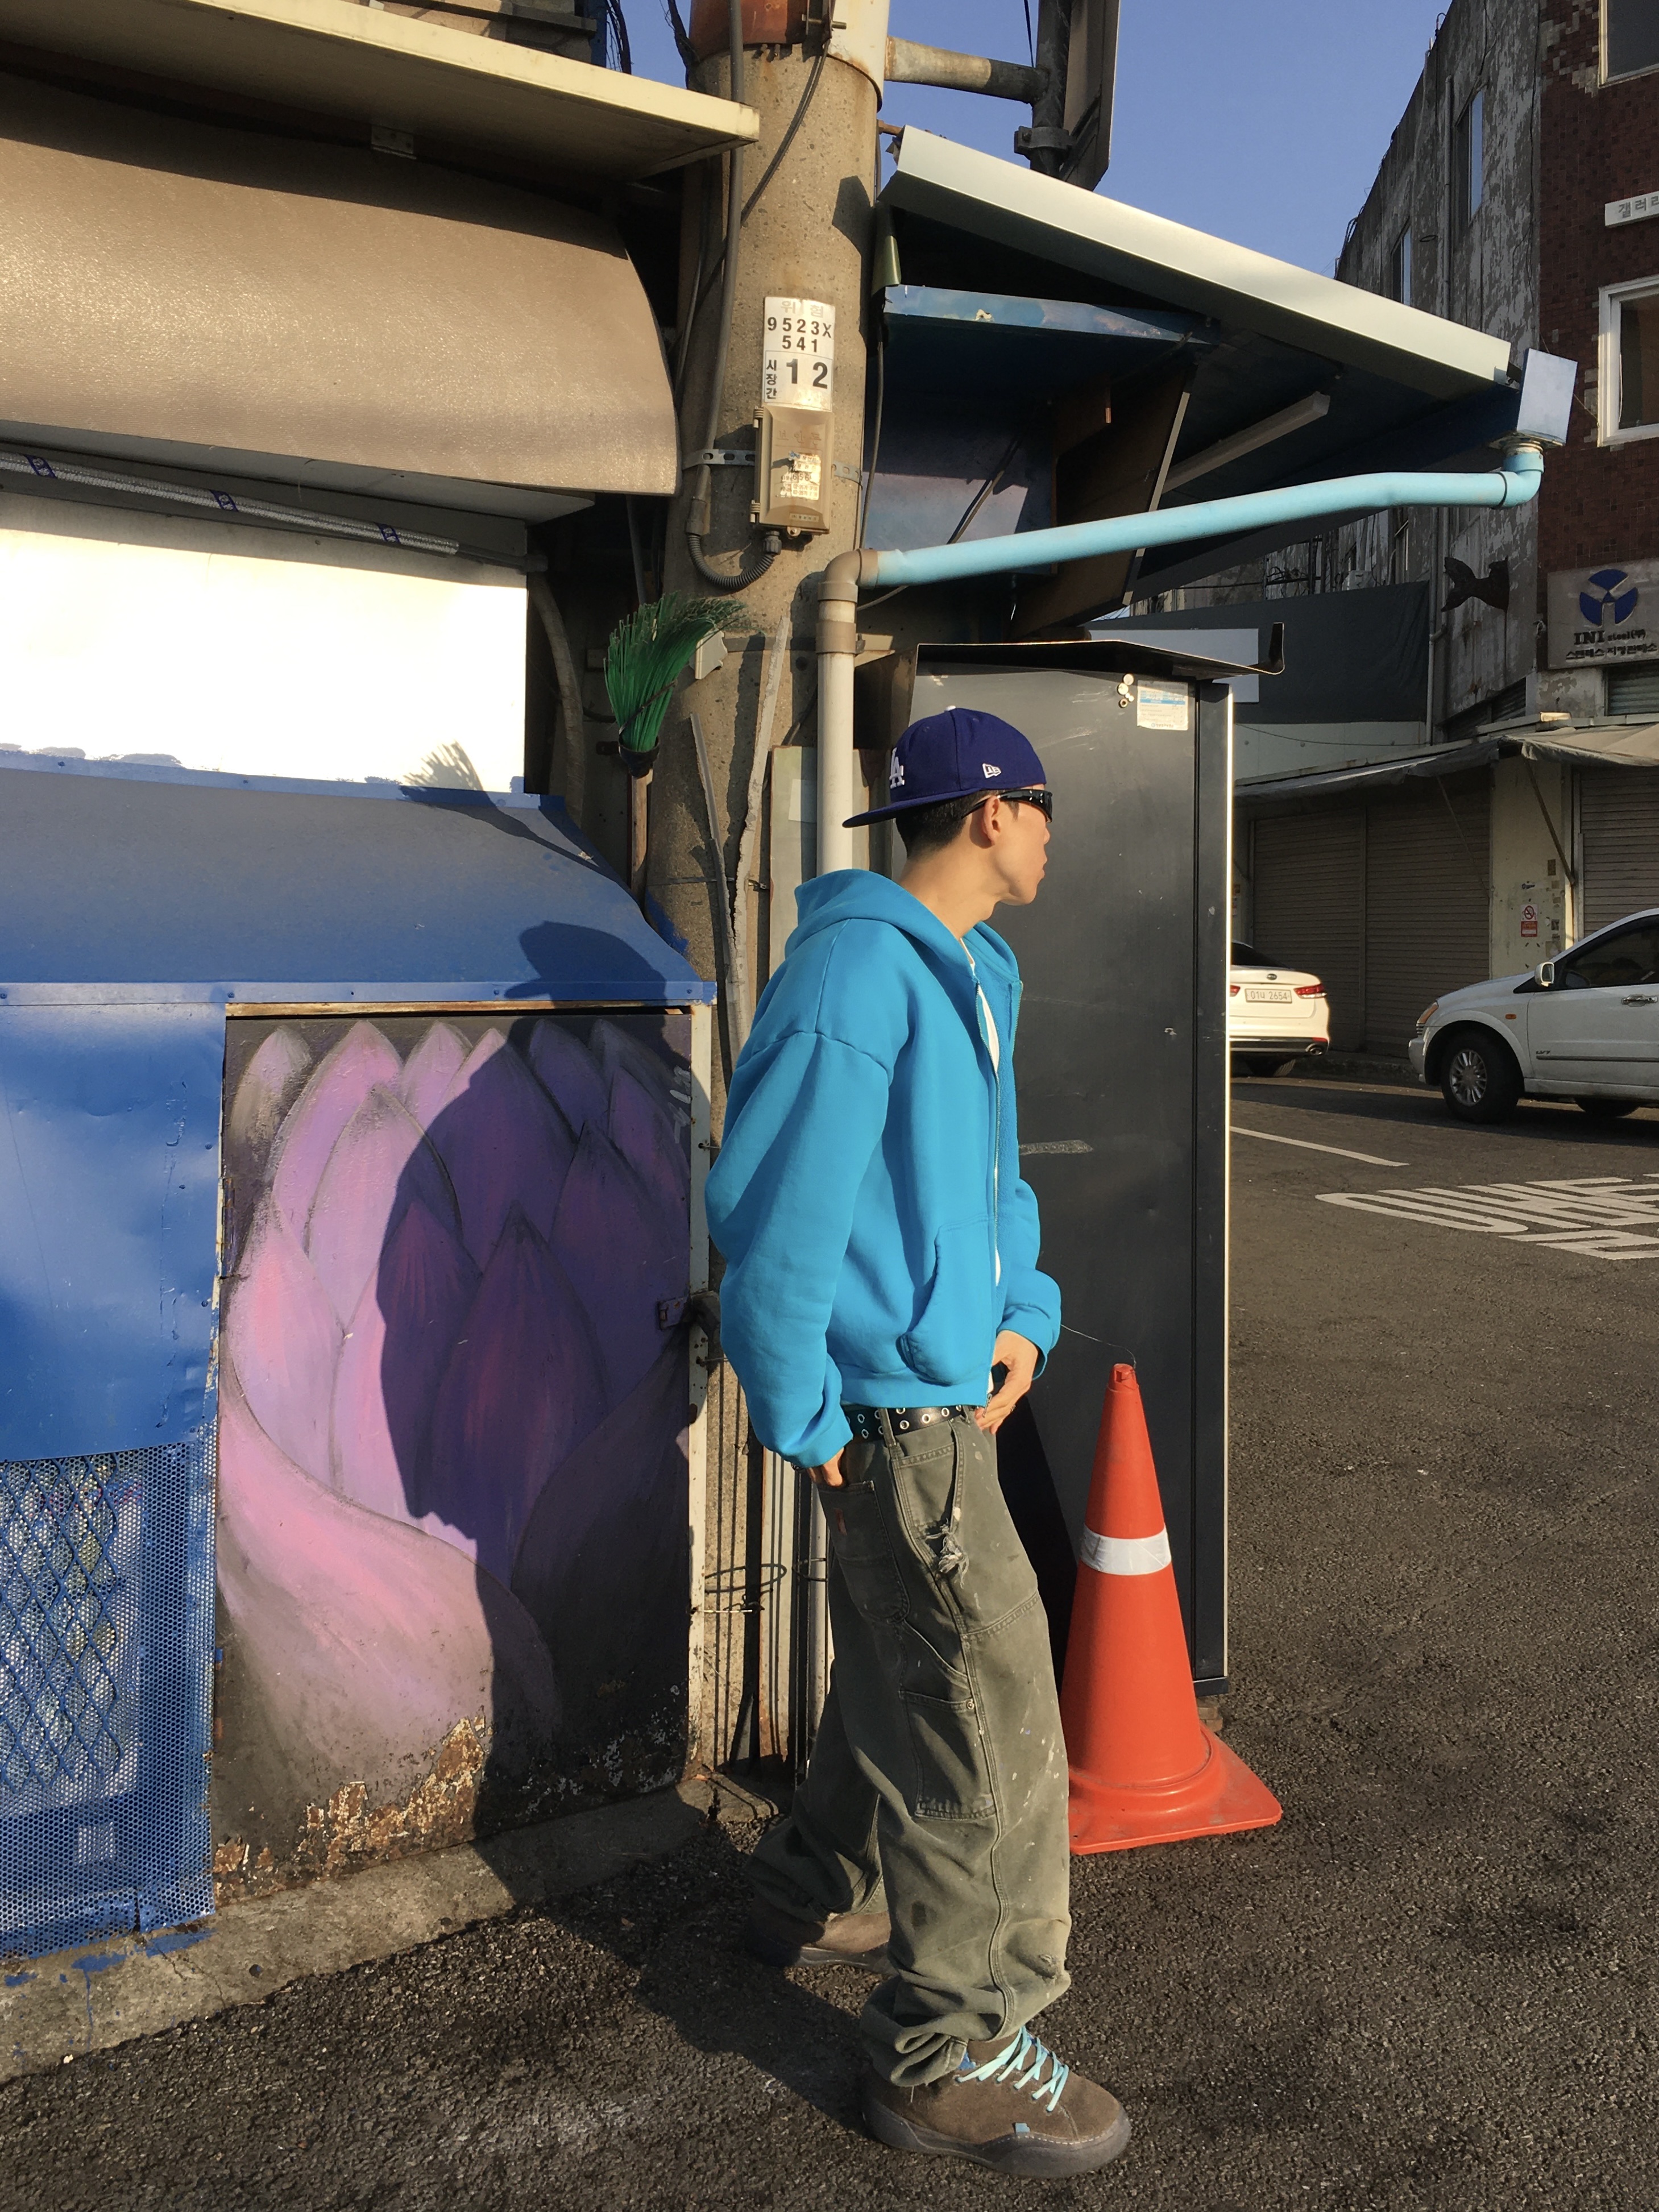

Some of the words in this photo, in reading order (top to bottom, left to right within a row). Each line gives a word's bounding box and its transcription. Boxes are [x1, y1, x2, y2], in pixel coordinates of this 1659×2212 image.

[767, 317, 832, 338] 9523X
[782, 335, 818, 352] 541
[1574, 630, 1605, 645] INI
[889, 747, 905, 789] LA
[1268, 991, 1288, 1001] 2654
